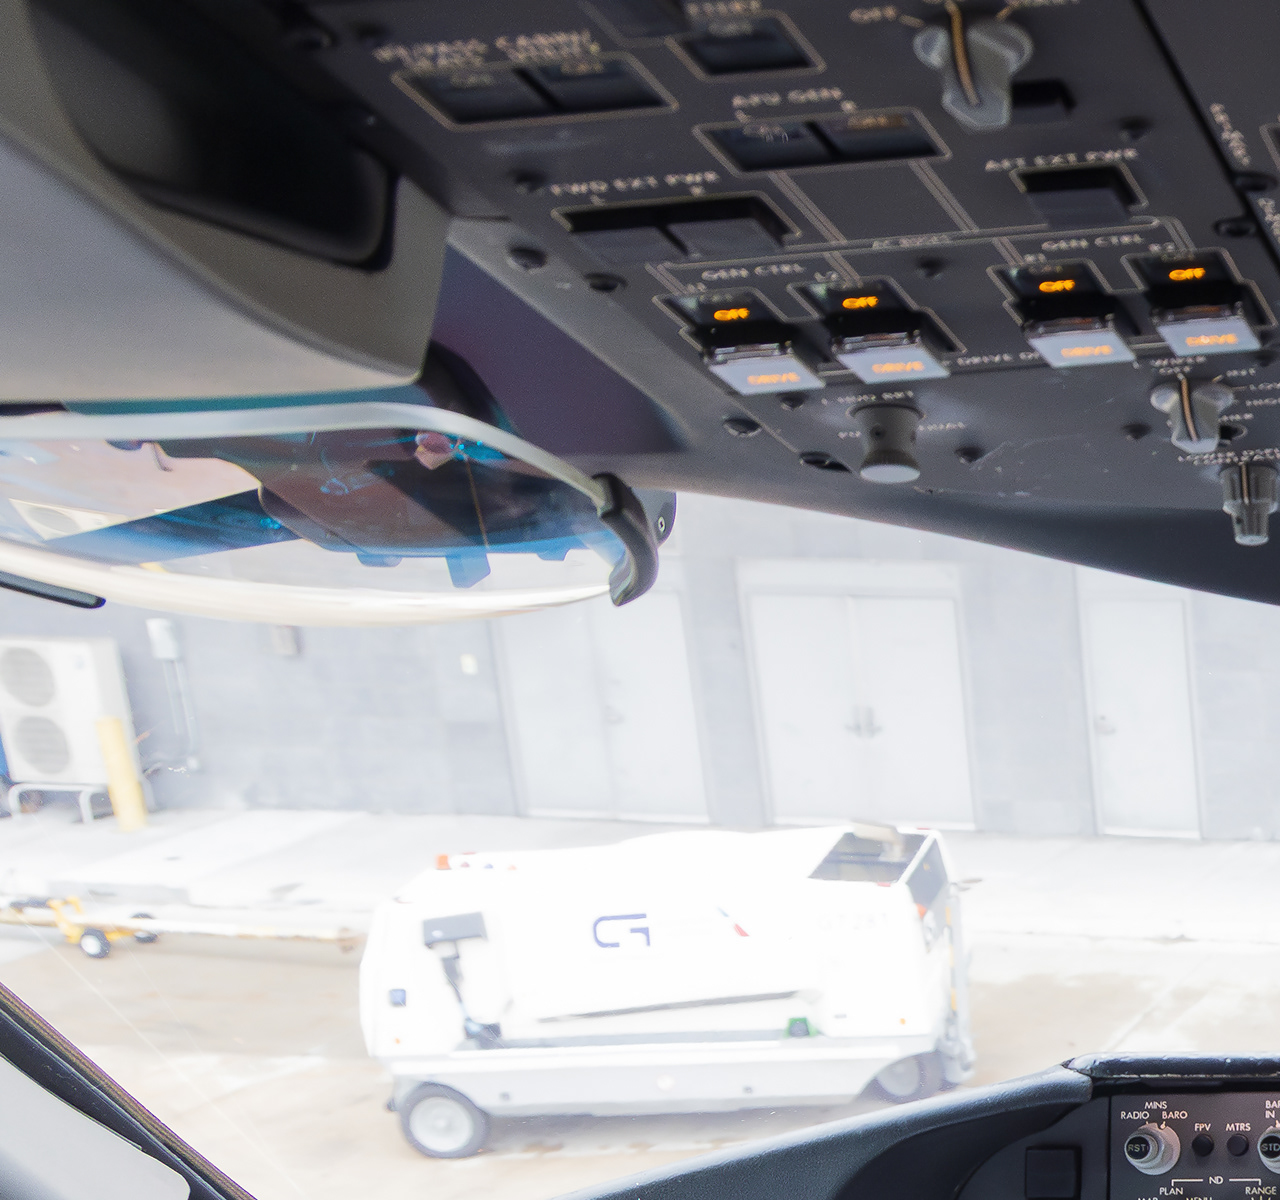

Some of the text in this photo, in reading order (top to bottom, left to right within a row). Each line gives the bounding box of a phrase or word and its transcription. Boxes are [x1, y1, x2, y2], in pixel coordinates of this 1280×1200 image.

[985, 149, 1138, 172] AFT EXT PWR
[1121, 1111, 1149, 1119] RADIO
[1195, 1123, 1211, 1131] FPV
[1226, 1123, 1250, 1131] MTRS
[1160, 1187, 1183, 1195] PLAN
